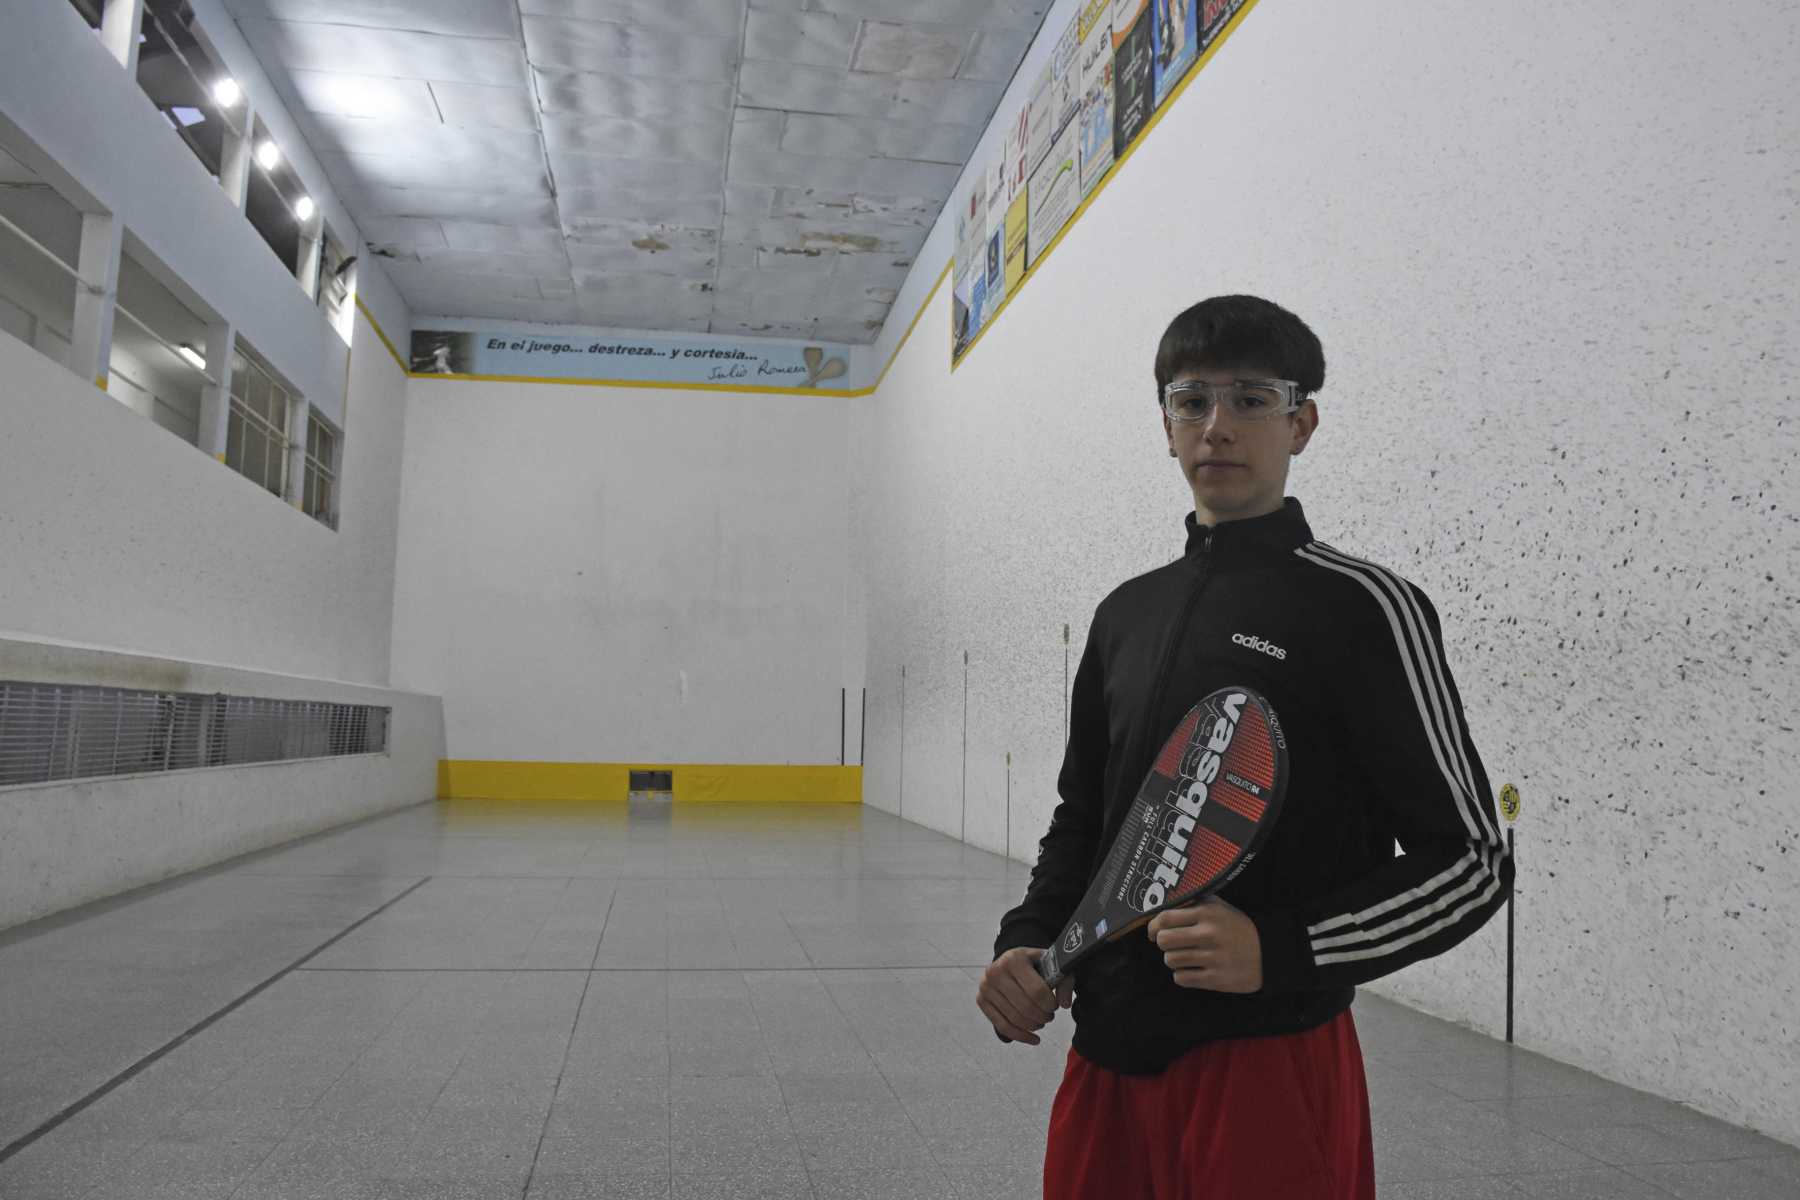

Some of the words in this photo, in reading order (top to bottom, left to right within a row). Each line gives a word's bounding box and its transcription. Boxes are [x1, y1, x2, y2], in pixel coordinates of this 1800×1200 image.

[486, 338, 506, 350] En
[511, 339, 526, 351] el
[527, 340, 583, 354] juego...
[588, 343, 666, 357] destreza...
[669, 348, 680, 360] y
[1231, 633, 1287, 660] adidas
